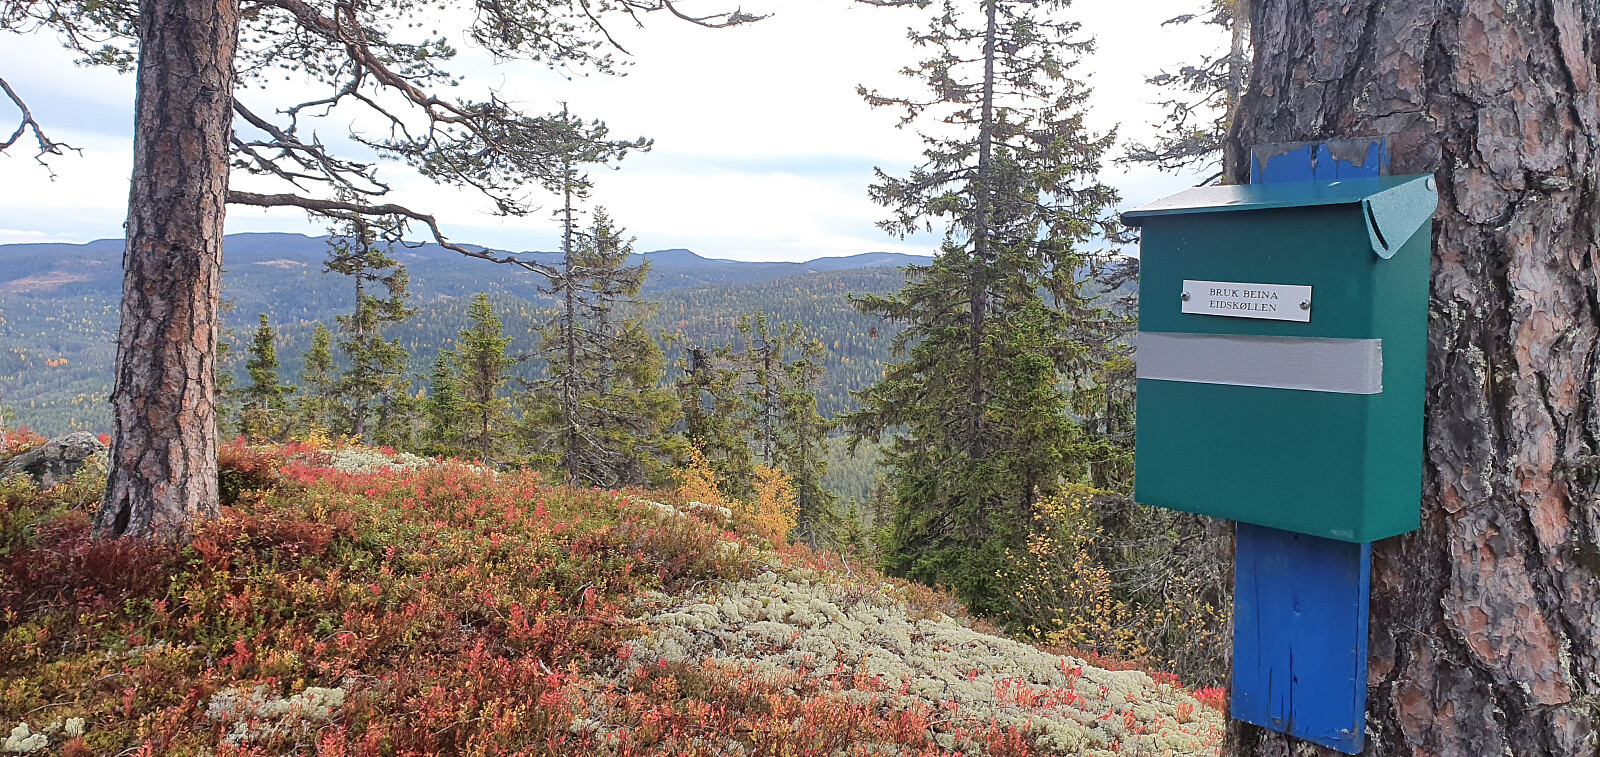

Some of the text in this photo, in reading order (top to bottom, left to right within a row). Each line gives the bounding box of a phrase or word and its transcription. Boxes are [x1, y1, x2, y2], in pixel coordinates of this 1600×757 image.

[1209, 288, 1279, 300] BRUK BEINA
[1209, 300, 1277, 312] EIDSKØLLEN
